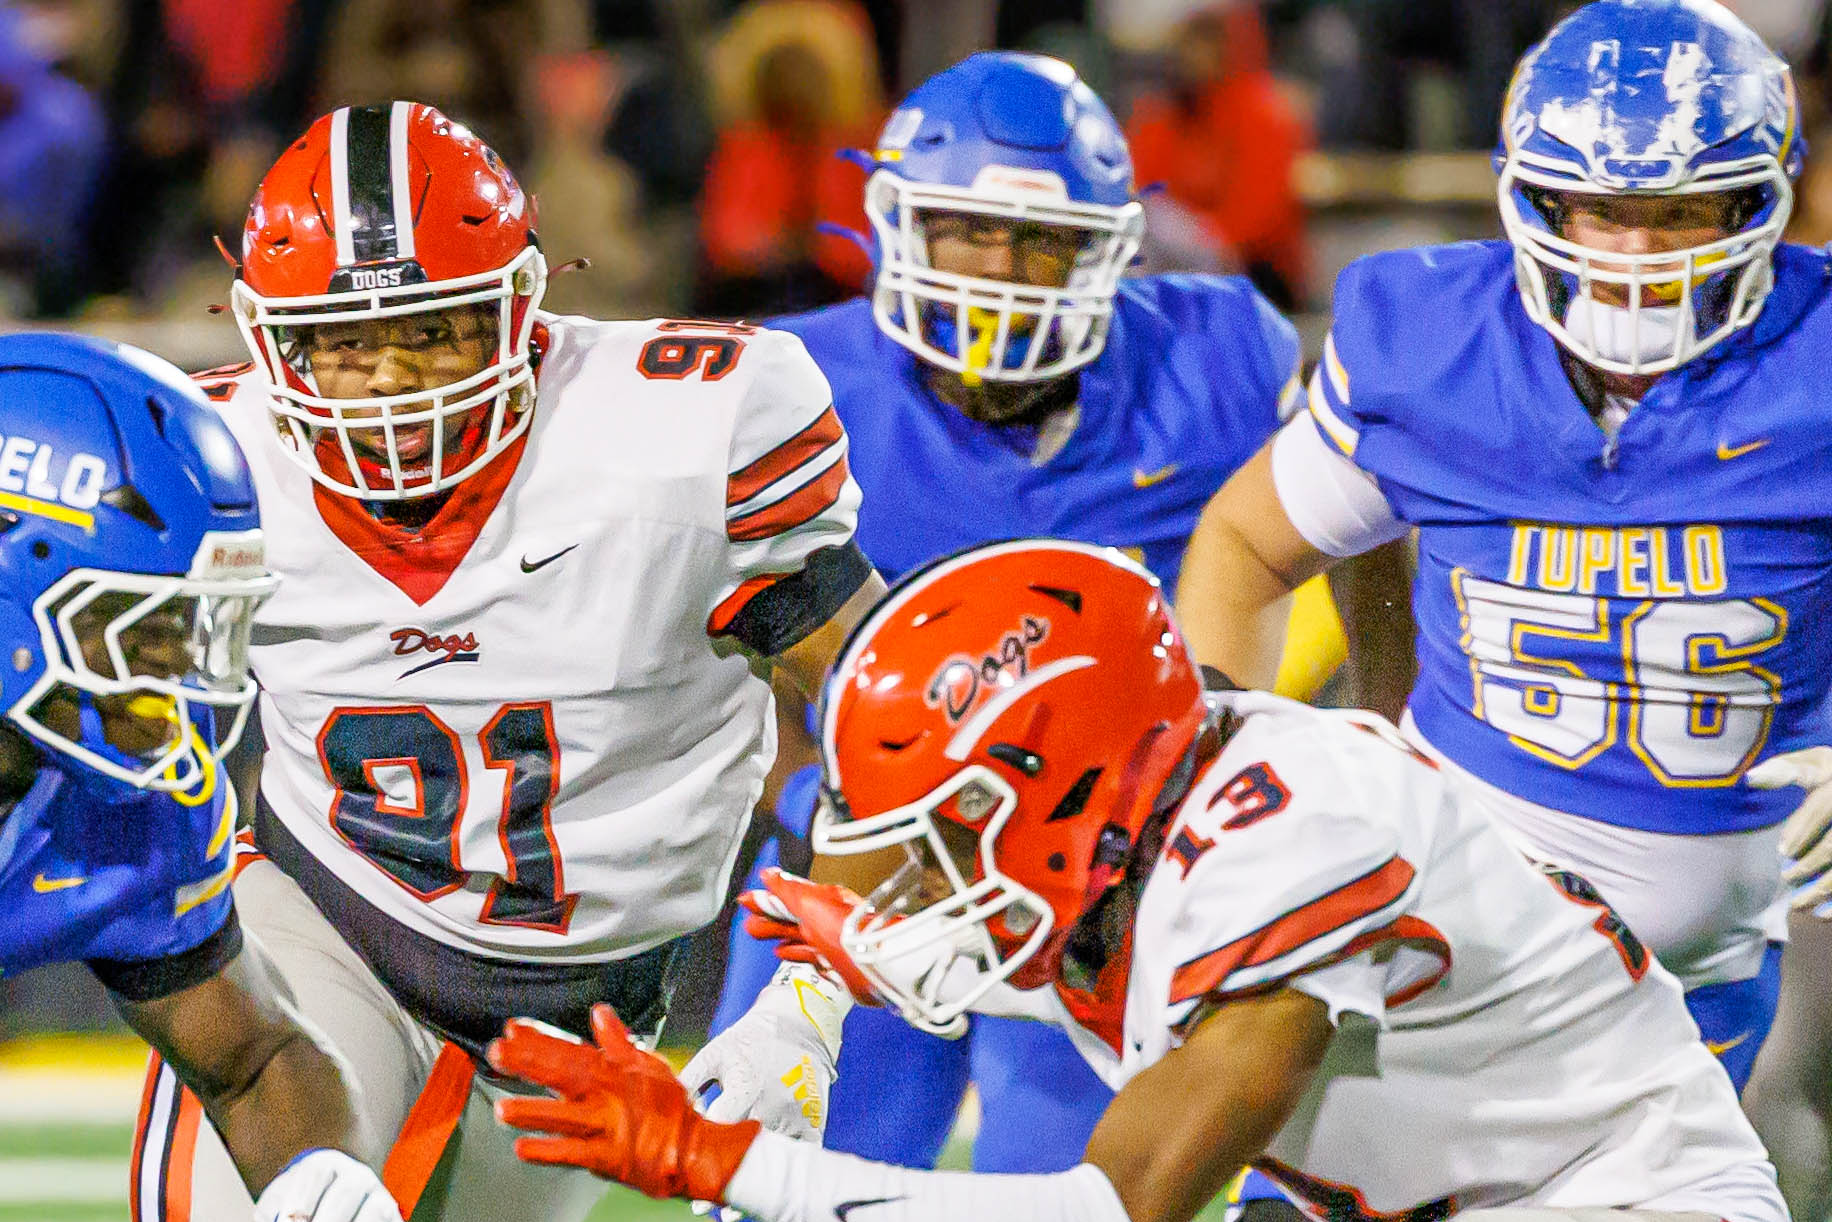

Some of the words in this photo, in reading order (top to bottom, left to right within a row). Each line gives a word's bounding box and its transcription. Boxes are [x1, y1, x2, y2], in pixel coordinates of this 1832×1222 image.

[352, 267, 402, 290] DOGS
[1507, 520, 1728, 598] TUPELO
[389, 627, 481, 661] Dogs
[929, 617, 1048, 722] Dogs
[1450, 566, 1789, 788] 56
[315, 700, 580, 936] 91
[1166, 761, 1293, 881] 13
